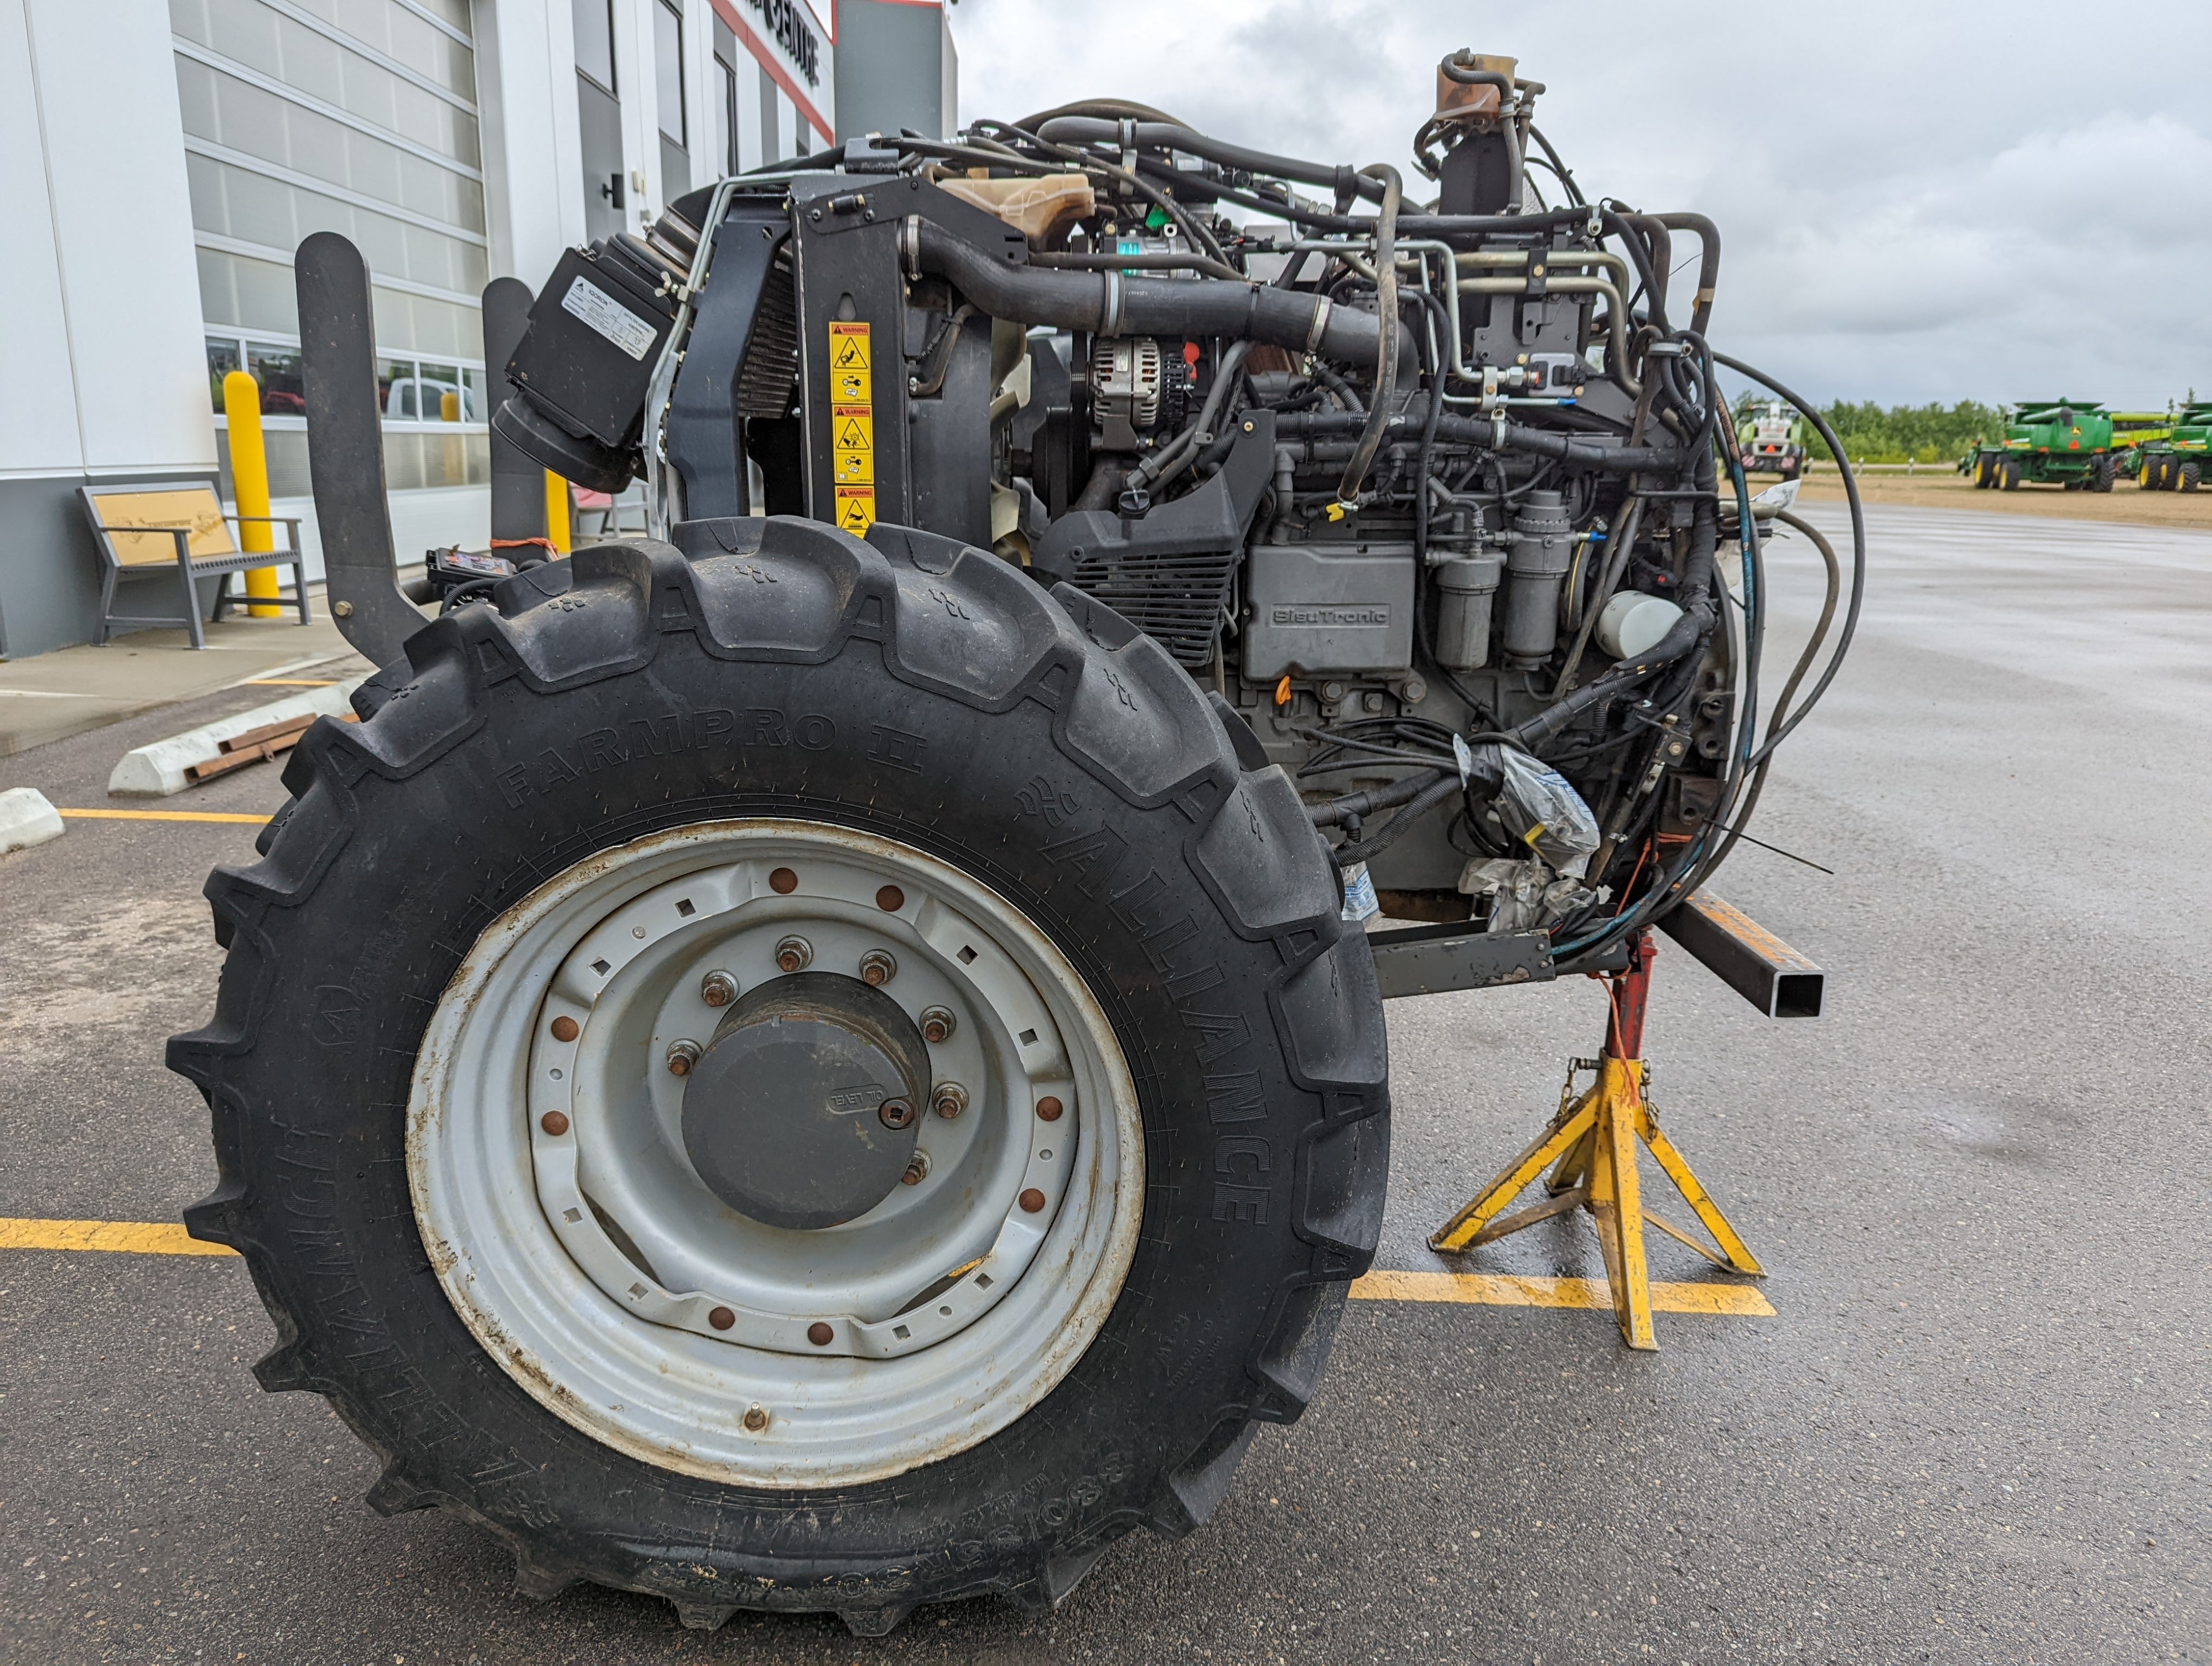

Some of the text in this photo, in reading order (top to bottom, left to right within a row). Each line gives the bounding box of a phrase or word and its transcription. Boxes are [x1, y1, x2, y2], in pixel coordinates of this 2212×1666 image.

[762, 0, 820, 86] CENTRE
[1273, 609, 1388, 623] SisuTronic
[494, 706, 928, 809] FARMPRO II
[1037, 821, 1272, 1226] ALLIANCE
[831, 1090, 884, 1106] OIL LEVEL
